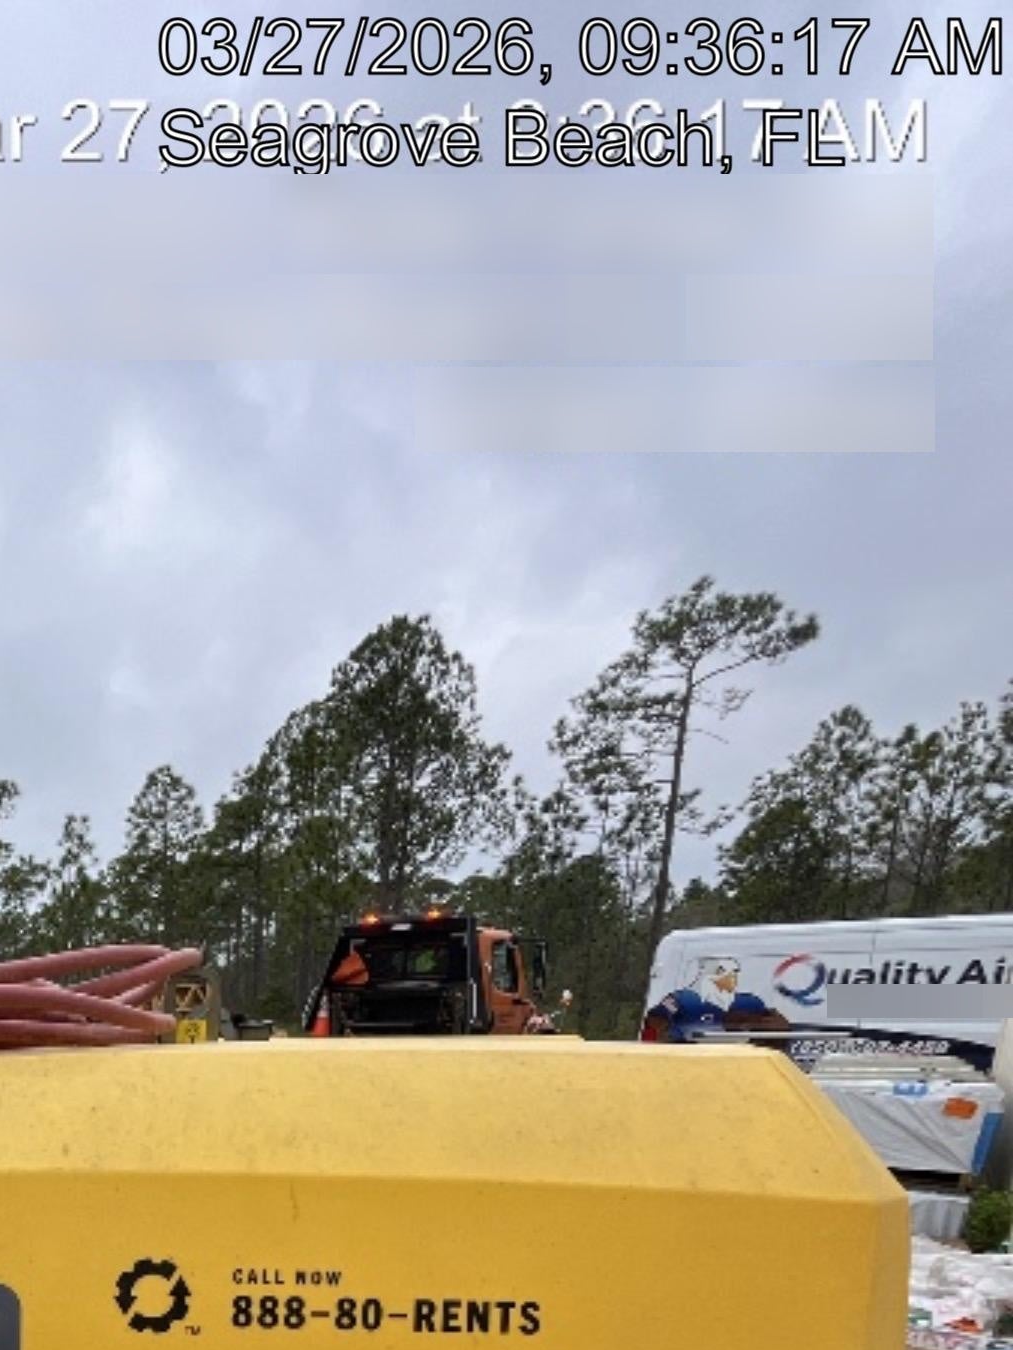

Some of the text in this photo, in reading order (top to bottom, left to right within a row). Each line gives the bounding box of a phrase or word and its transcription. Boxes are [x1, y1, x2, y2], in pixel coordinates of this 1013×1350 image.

[955, 957, 1013, 985] Ai
[232, 1268, 342, 1287] CALL NOW
[231, 1296, 541, 1336] 888-80-RENTS
